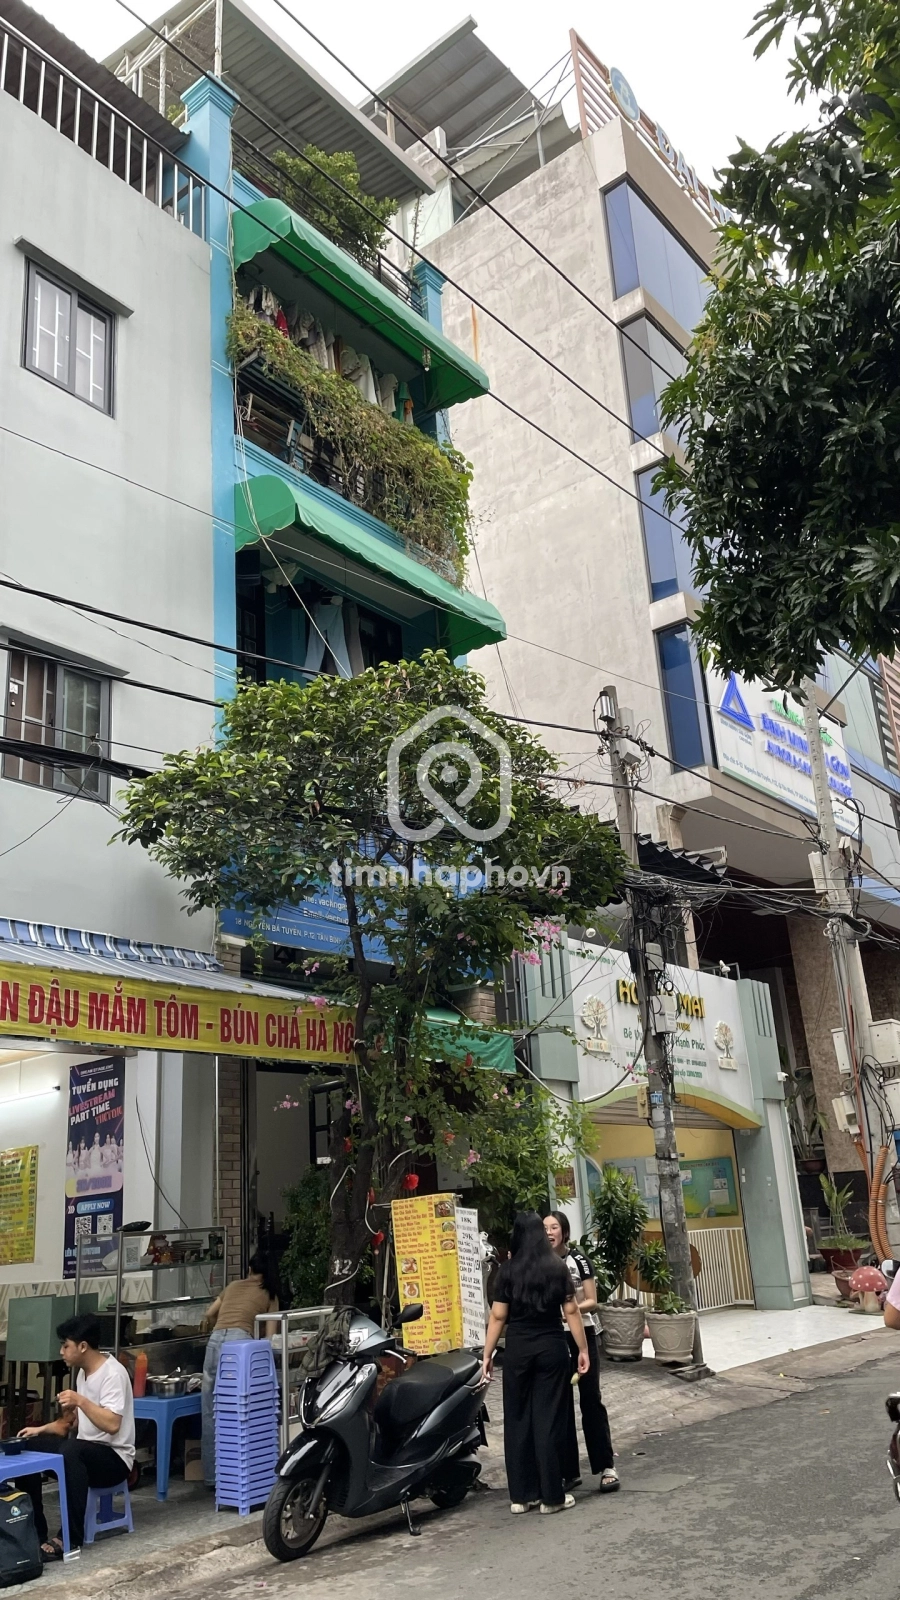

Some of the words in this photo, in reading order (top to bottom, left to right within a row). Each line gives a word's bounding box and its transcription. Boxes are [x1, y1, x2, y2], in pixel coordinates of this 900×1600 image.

[28, 979, 79, 1034] ĐẬU
[88, 980, 147, 1034] MẮM
[154, 993, 198, 1040] TÔM
[220, 1003, 258, 1046] BÚN
[265, 1006, 300, 1050] CHẢ
[306, 1012, 328, 1052] HÀ
[333, 1017, 356, 1061] NỘ
[72, 1077, 96, 1095] TUYỂN
[98, 1077, 118, 1091] DỤNG
[69, 1088, 116, 1116] LIVESTREAM
[70, 1109, 90, 1126] PART
[91, 1101, 111, 1117] TIME
[95, 1105, 123, 1125] TIKTOK
[80, 1202, 97, 1211] APPLY
[97, 1200, 111, 1209] NOW
[333, 1259, 352, 1275] 12
